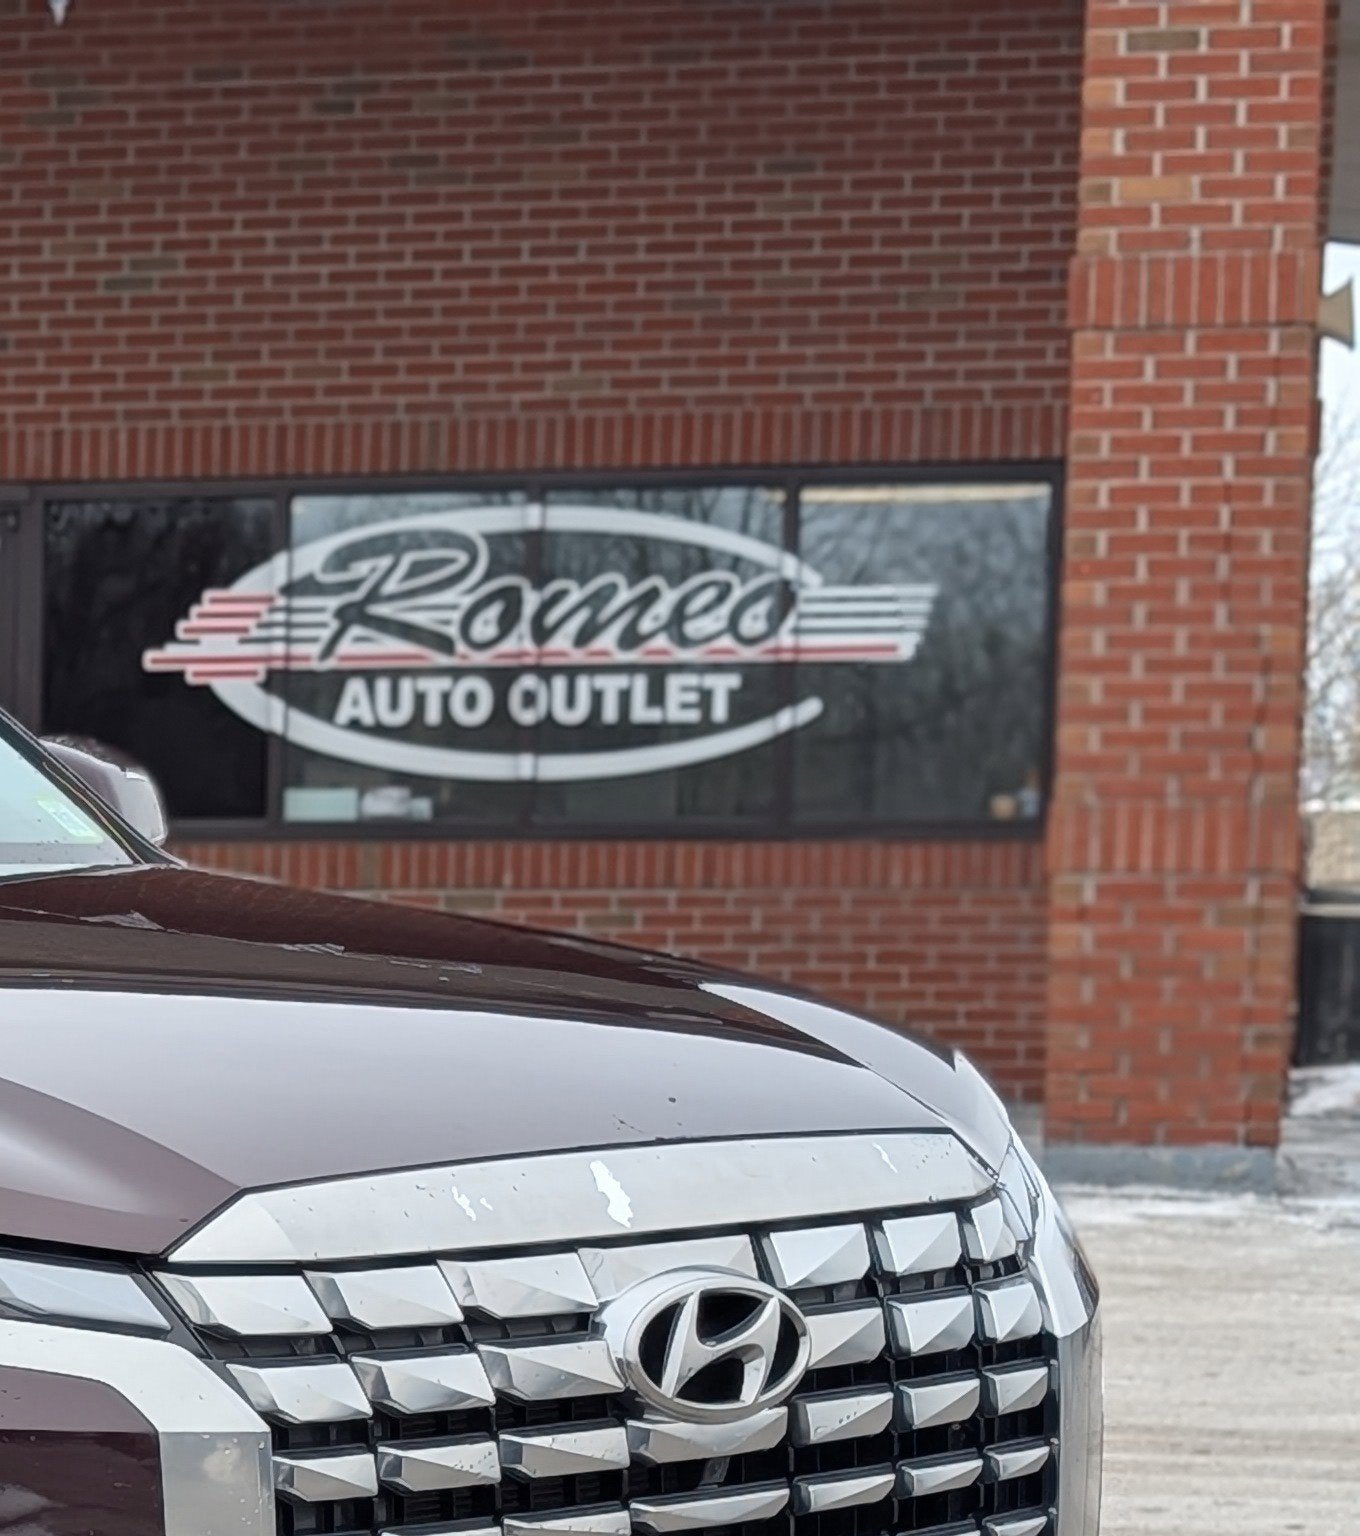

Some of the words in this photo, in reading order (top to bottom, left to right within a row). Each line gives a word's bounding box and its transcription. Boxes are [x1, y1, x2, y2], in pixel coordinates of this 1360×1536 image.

[308, 527, 799, 664] Romeo
[334, 677, 493, 727] AUTO
[508, 673, 742, 727] OUTLET
